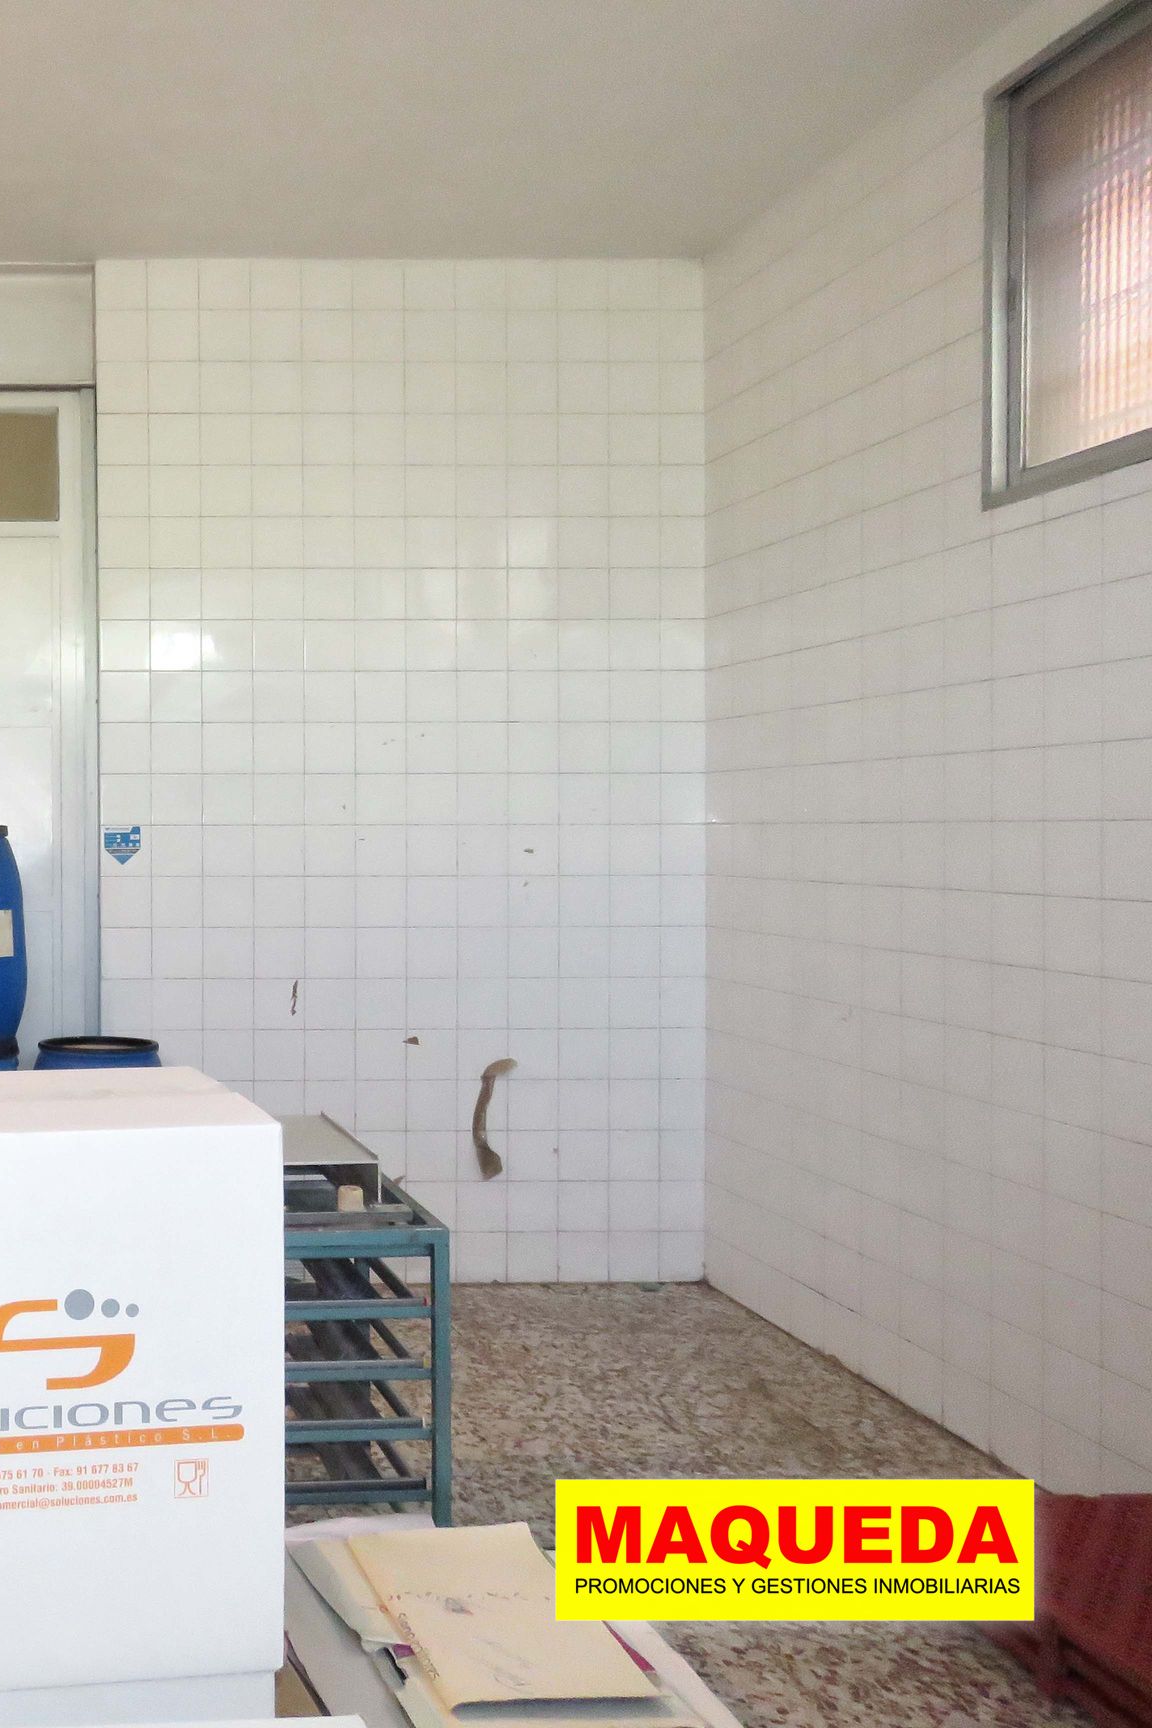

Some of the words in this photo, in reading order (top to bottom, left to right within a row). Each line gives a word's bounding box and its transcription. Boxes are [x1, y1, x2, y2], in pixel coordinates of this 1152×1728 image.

[16, 1440, 39, 1450] en
[56, 1432, 162, 1448] Plástico
[16, 1469, 28, 1479] 61
[32, 1468, 44, 1478] 70
[76, 1465, 88, 1475] 91
[91, 1464, 109, 1474] 677
